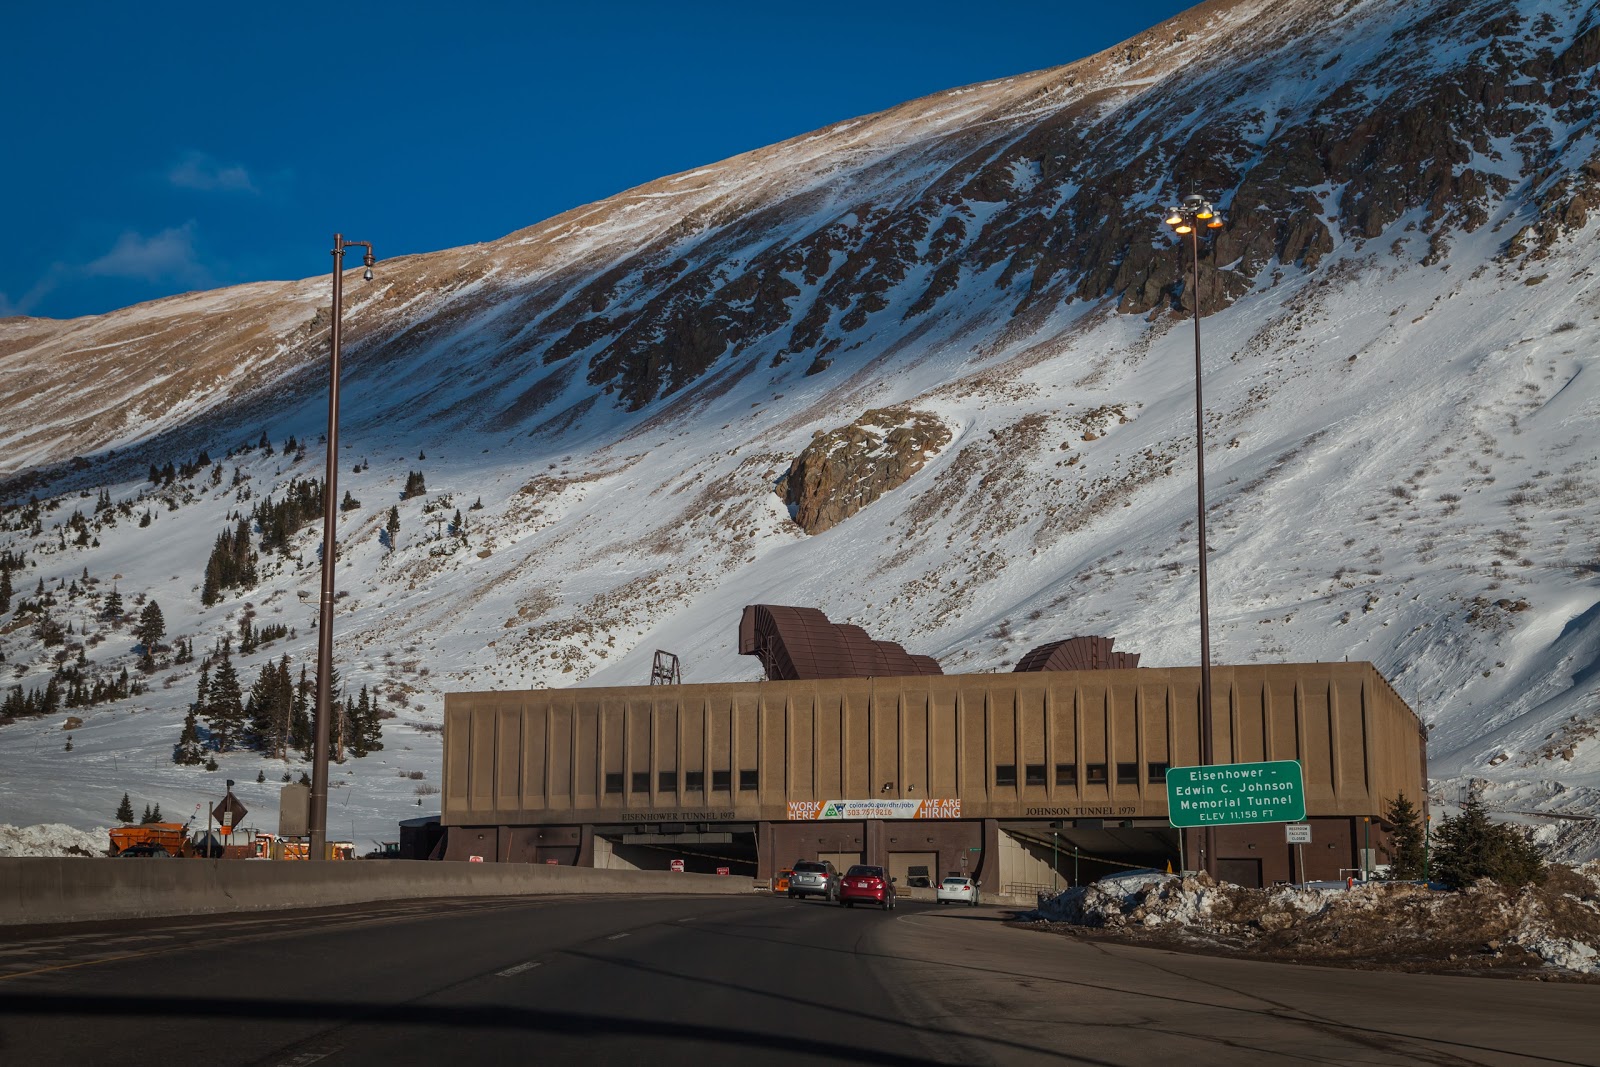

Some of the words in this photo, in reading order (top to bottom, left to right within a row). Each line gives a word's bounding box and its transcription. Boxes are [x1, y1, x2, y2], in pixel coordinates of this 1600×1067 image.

[1190, 769, 1263, 781] Eisenhower
[1176, 785, 1214, 796] Edwin
[1221, 784, 1232, 793] C.
[1239, 782, 1293, 793] Johnson
[789, 802, 821, 811] WORK
[925, 799, 940, 807] WE
[942, 799, 961, 807] ARE
[1181, 798, 1240, 810] Memorial
[1247, 795, 1292, 806] Tunnel
[622, 813, 678, 821] EISENHOWER
[682, 812, 717, 820] TUNNEL
[720, 811, 735, 819] 1973
[788, 811, 816, 820] HERE
[920, 808, 961, 818] HIRING
[1026, 807, 1070, 816] JOHNSON
[1074, 807, 1115, 816] TUNNEL
[1119, 806, 1136, 815] 1979
[1200, 812, 1225, 821] ELEV
[1230, 811, 1257, 819] 11,158
[1262, 809, 1274, 817] FT
